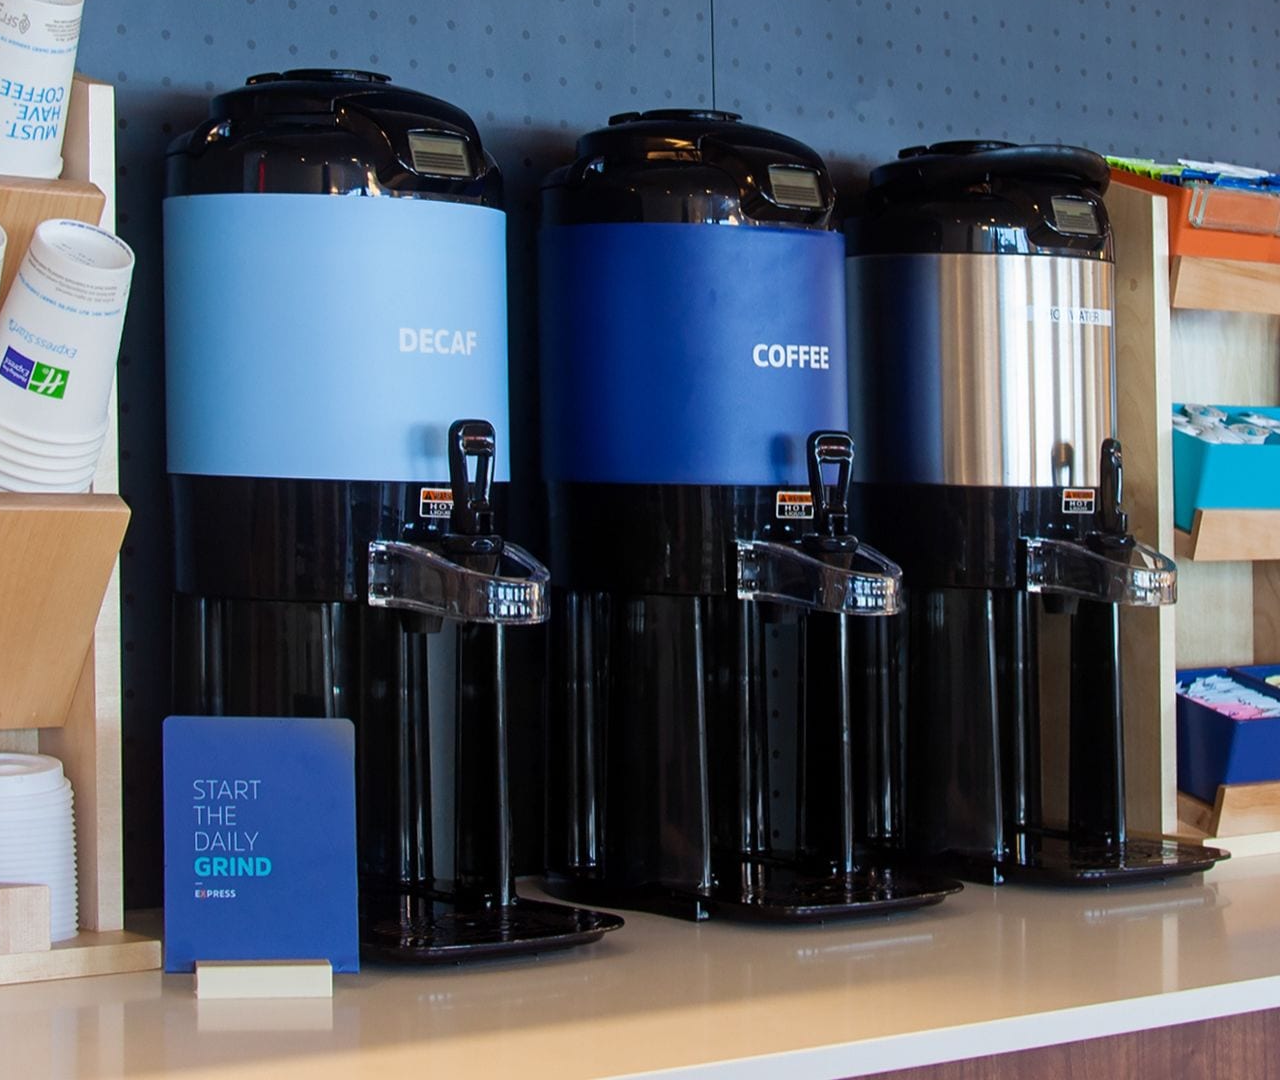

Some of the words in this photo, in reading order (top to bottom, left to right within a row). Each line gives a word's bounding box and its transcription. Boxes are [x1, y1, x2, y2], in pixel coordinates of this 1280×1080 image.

[13, 103, 61, 122] HAVE.
[6, 120, 58, 140] MUST.
[34, 337, 77, 358] Express
[400, 328, 477, 355] DECAF
[753, 343, 829, 369] COFFEE
[4, 357, 30, 377] Express
[193, 779, 261, 800] START
[193, 806, 237, 826] THE
[194, 832, 258, 851] DAILY
[194, 857, 272, 877] GRIND
[195, 889, 237, 898] EXPRESS
